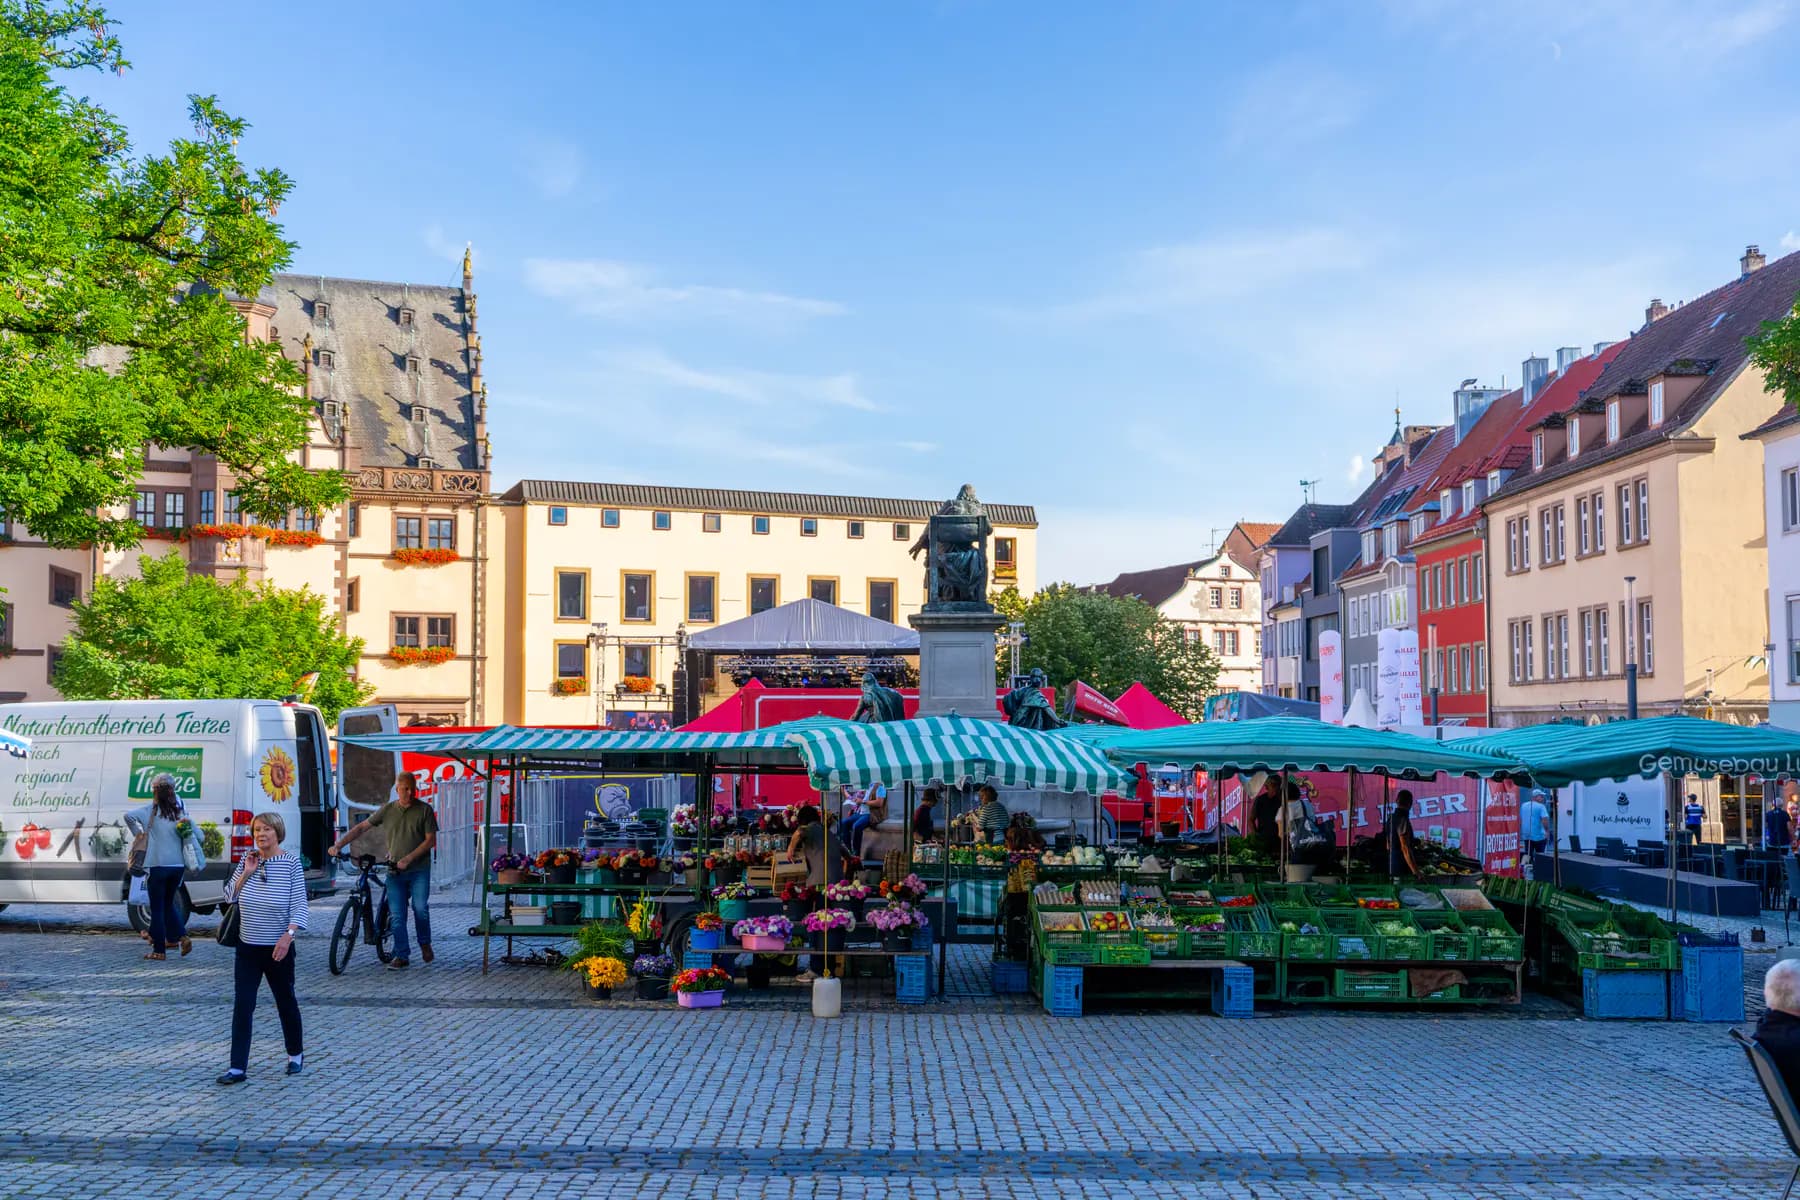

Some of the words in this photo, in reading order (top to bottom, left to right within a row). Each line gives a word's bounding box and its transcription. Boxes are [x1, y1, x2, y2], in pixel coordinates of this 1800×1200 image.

[3, 713, 166, 736] Naturlandbetrieb
[175, 711, 231, 734] Tietze
[14, 767, 77, 790] regional
[135, 765, 196, 793] Tize
[12, 791, 90, 812] bio-logisch
